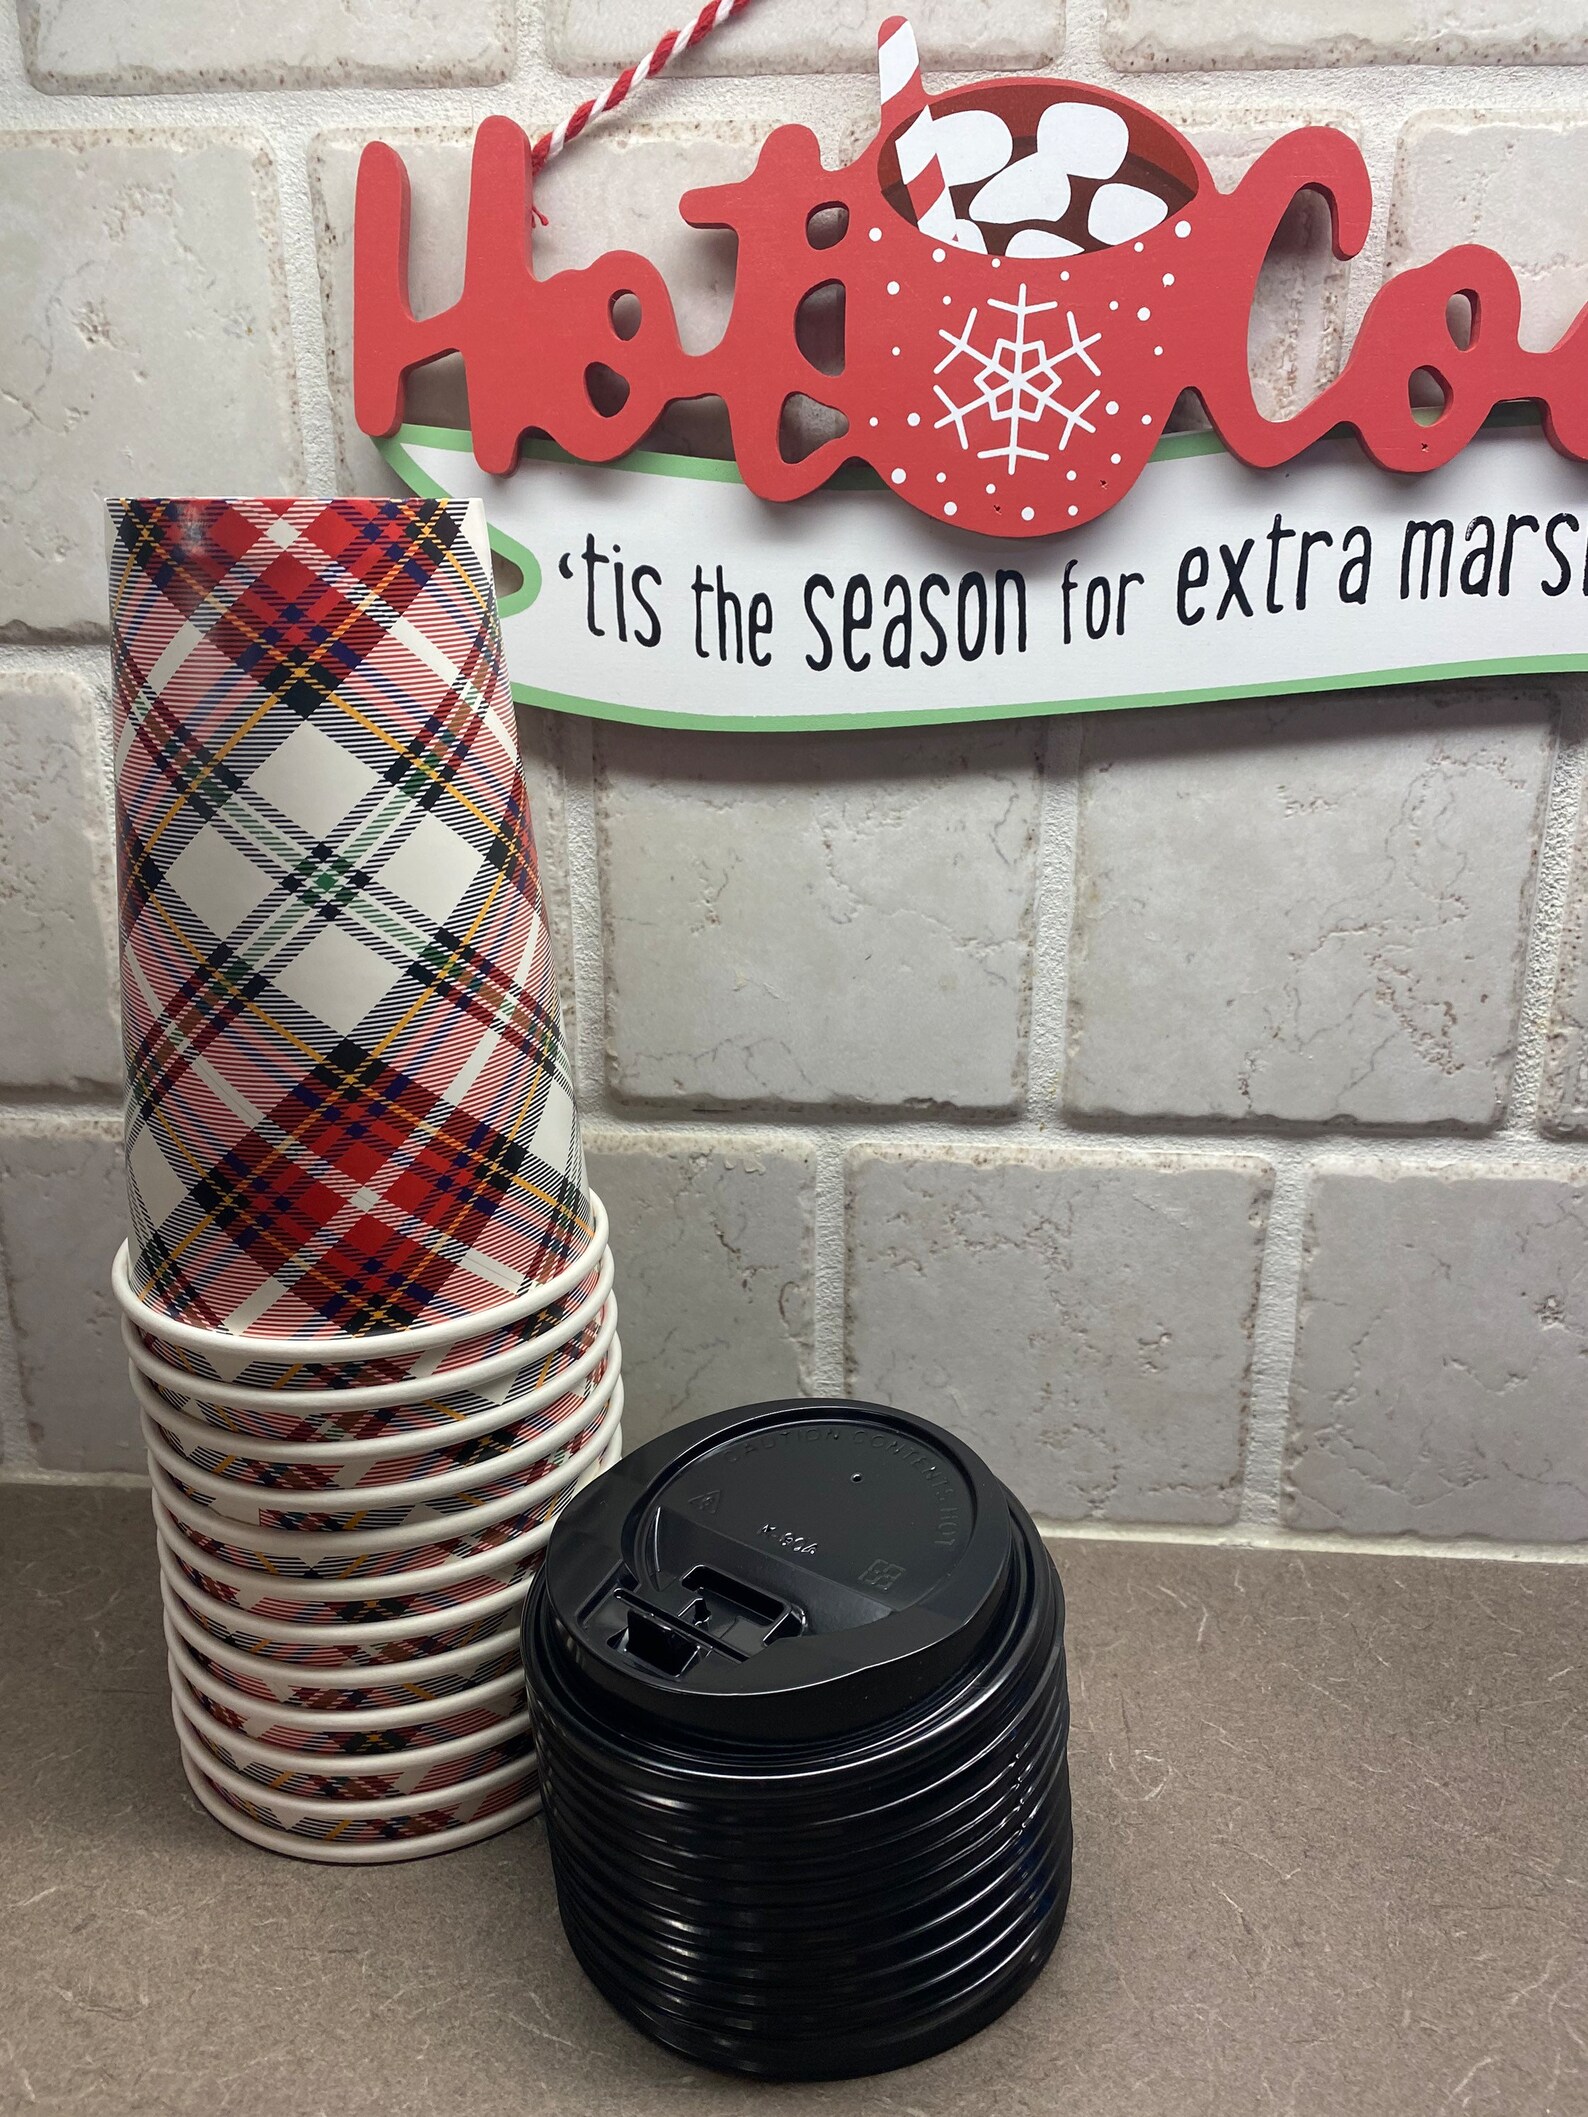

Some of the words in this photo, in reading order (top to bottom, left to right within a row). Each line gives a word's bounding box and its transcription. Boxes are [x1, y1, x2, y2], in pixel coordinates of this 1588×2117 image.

[354, 115, 860, 502] Hot
[692, 565, 772, 666] the
[804, 568, 1027, 671] season
[1062, 559, 1144, 644] for
[1177, 514, 1371, 625] extra
[1401, 513, 1588, 599] mars
[723, 1428, 841, 1463] CAUTION
[854, 1430, 954, 1501] CONTENTS
[934, 1507, 959, 1547] HOT
